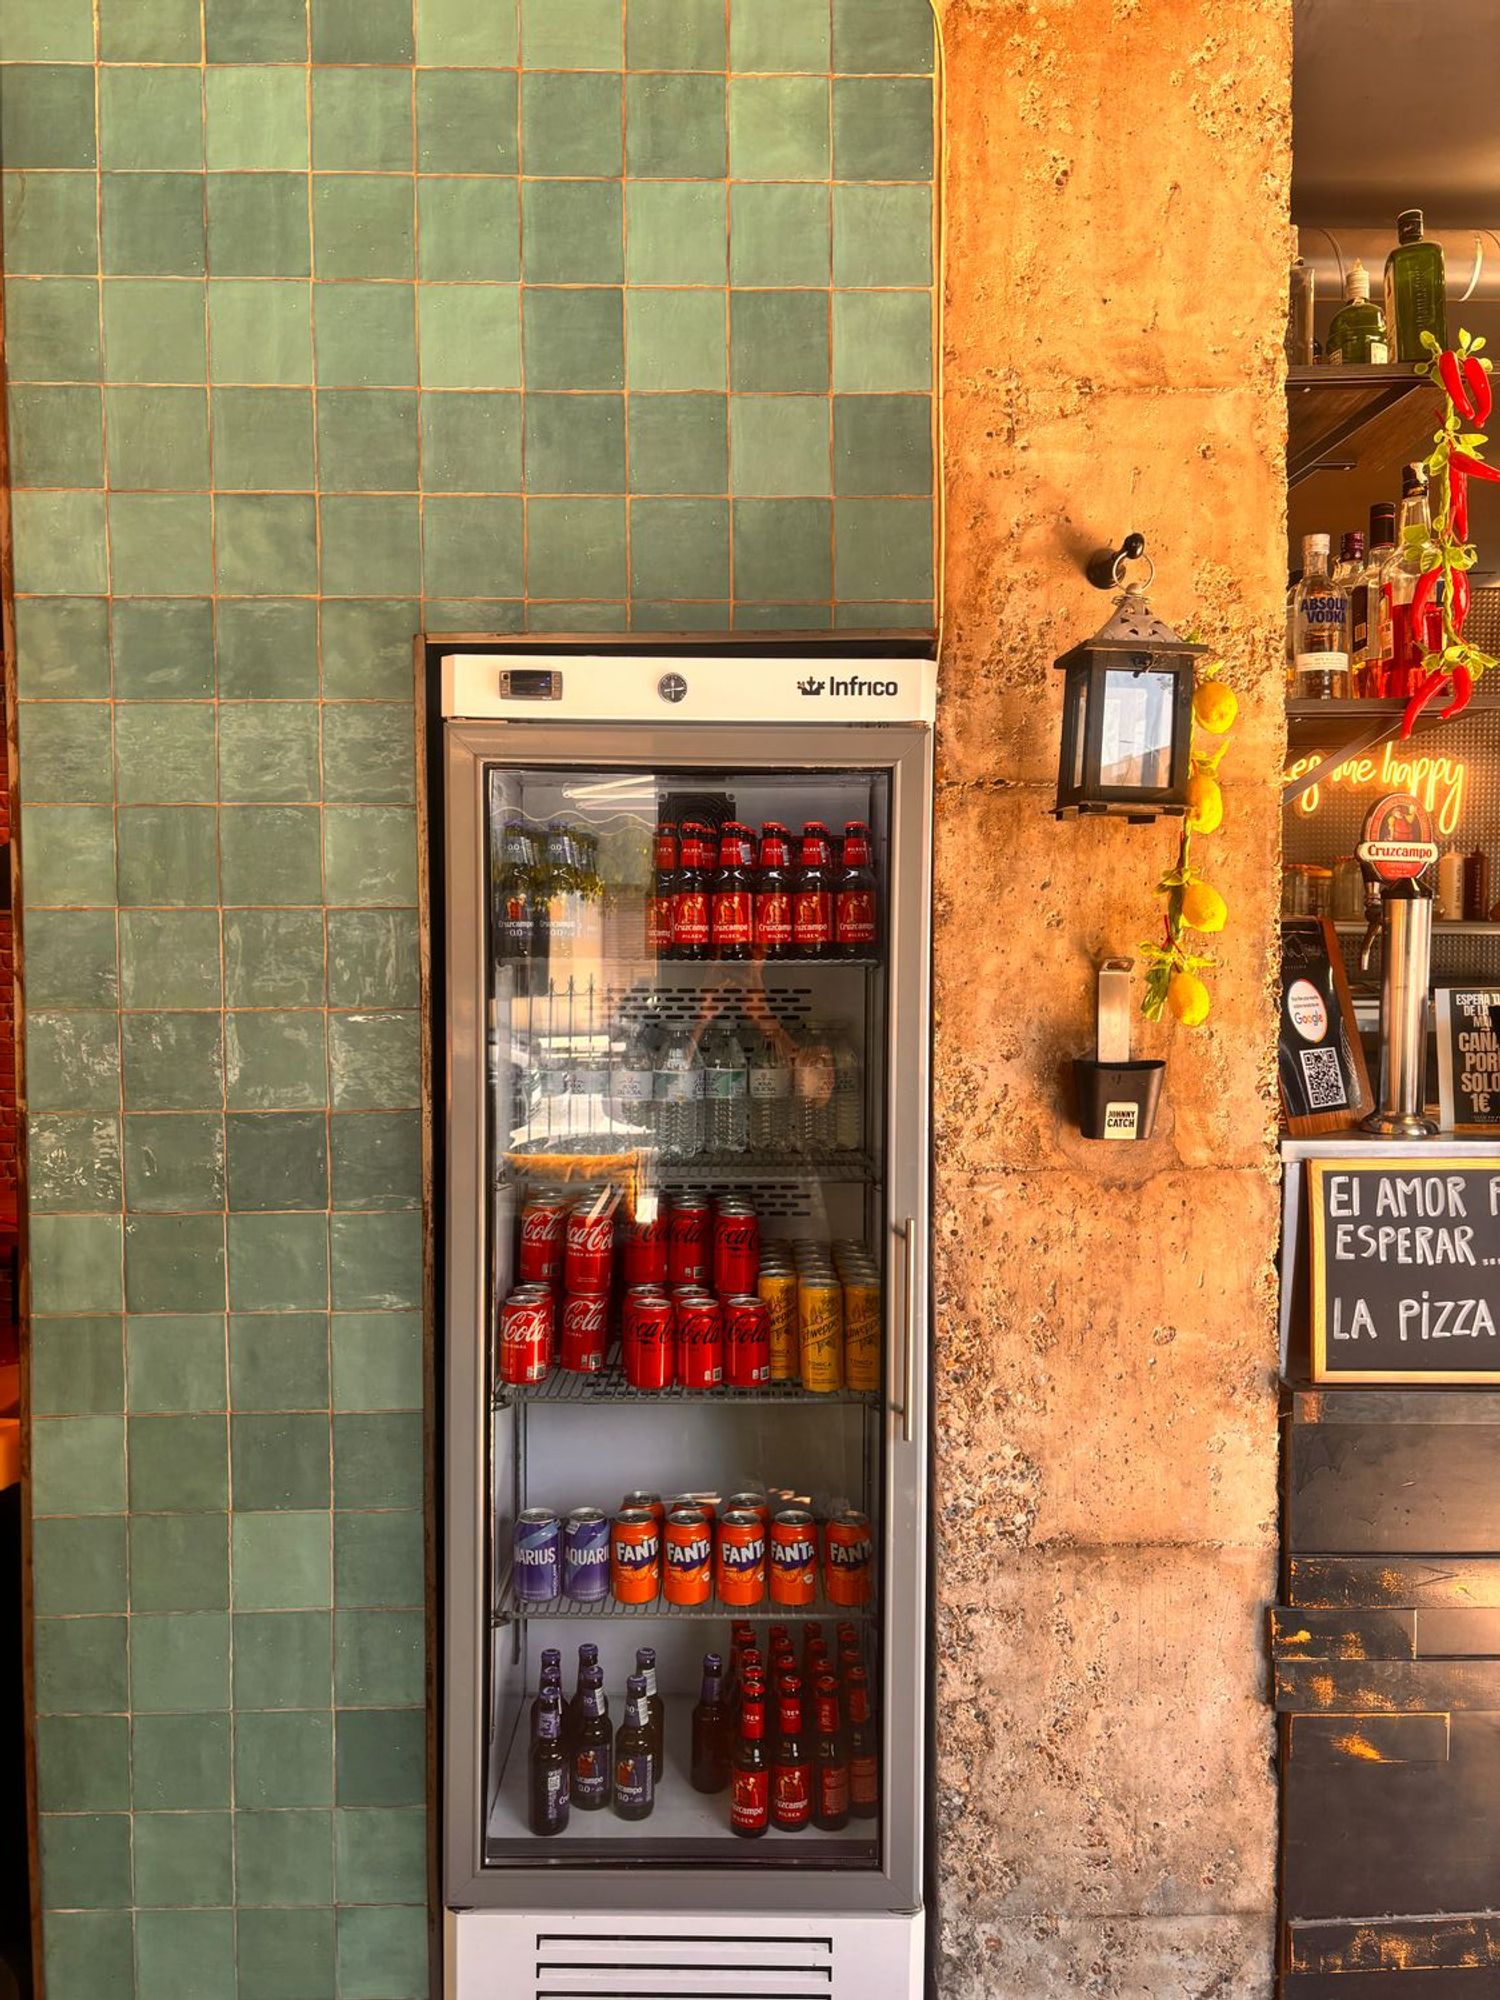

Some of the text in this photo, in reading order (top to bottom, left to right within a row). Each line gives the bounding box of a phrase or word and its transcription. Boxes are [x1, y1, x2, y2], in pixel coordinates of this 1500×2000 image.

[830, 676, 898, 696] Infrico
[1382, 741, 1465, 835] happy
[1367, 844, 1432, 858] Cruzcampo
[1455, 994, 1489, 1006] ESPERA
[1294, 1009, 1324, 1027] Google
[1463, 1006, 1489, 1016] DE LA
[1465, 1052, 1498, 1072] POR
[1461, 1072, 1500, 1092] SOLO
[1470, 1093, 1491, 1113] 1€
[1107, 1110, 1136, 1118] JOHNNY
[1107, 1118, 1135, 1128] CATCH
[1376, 1176, 1467, 1217] AMOR
[563, 1300, 605, 1331] Cola
[1333, 1297, 1378, 1340] LA
[504, 1310, 547, 1343] Cola
[514, 1546, 556, 1566] ARIUS
